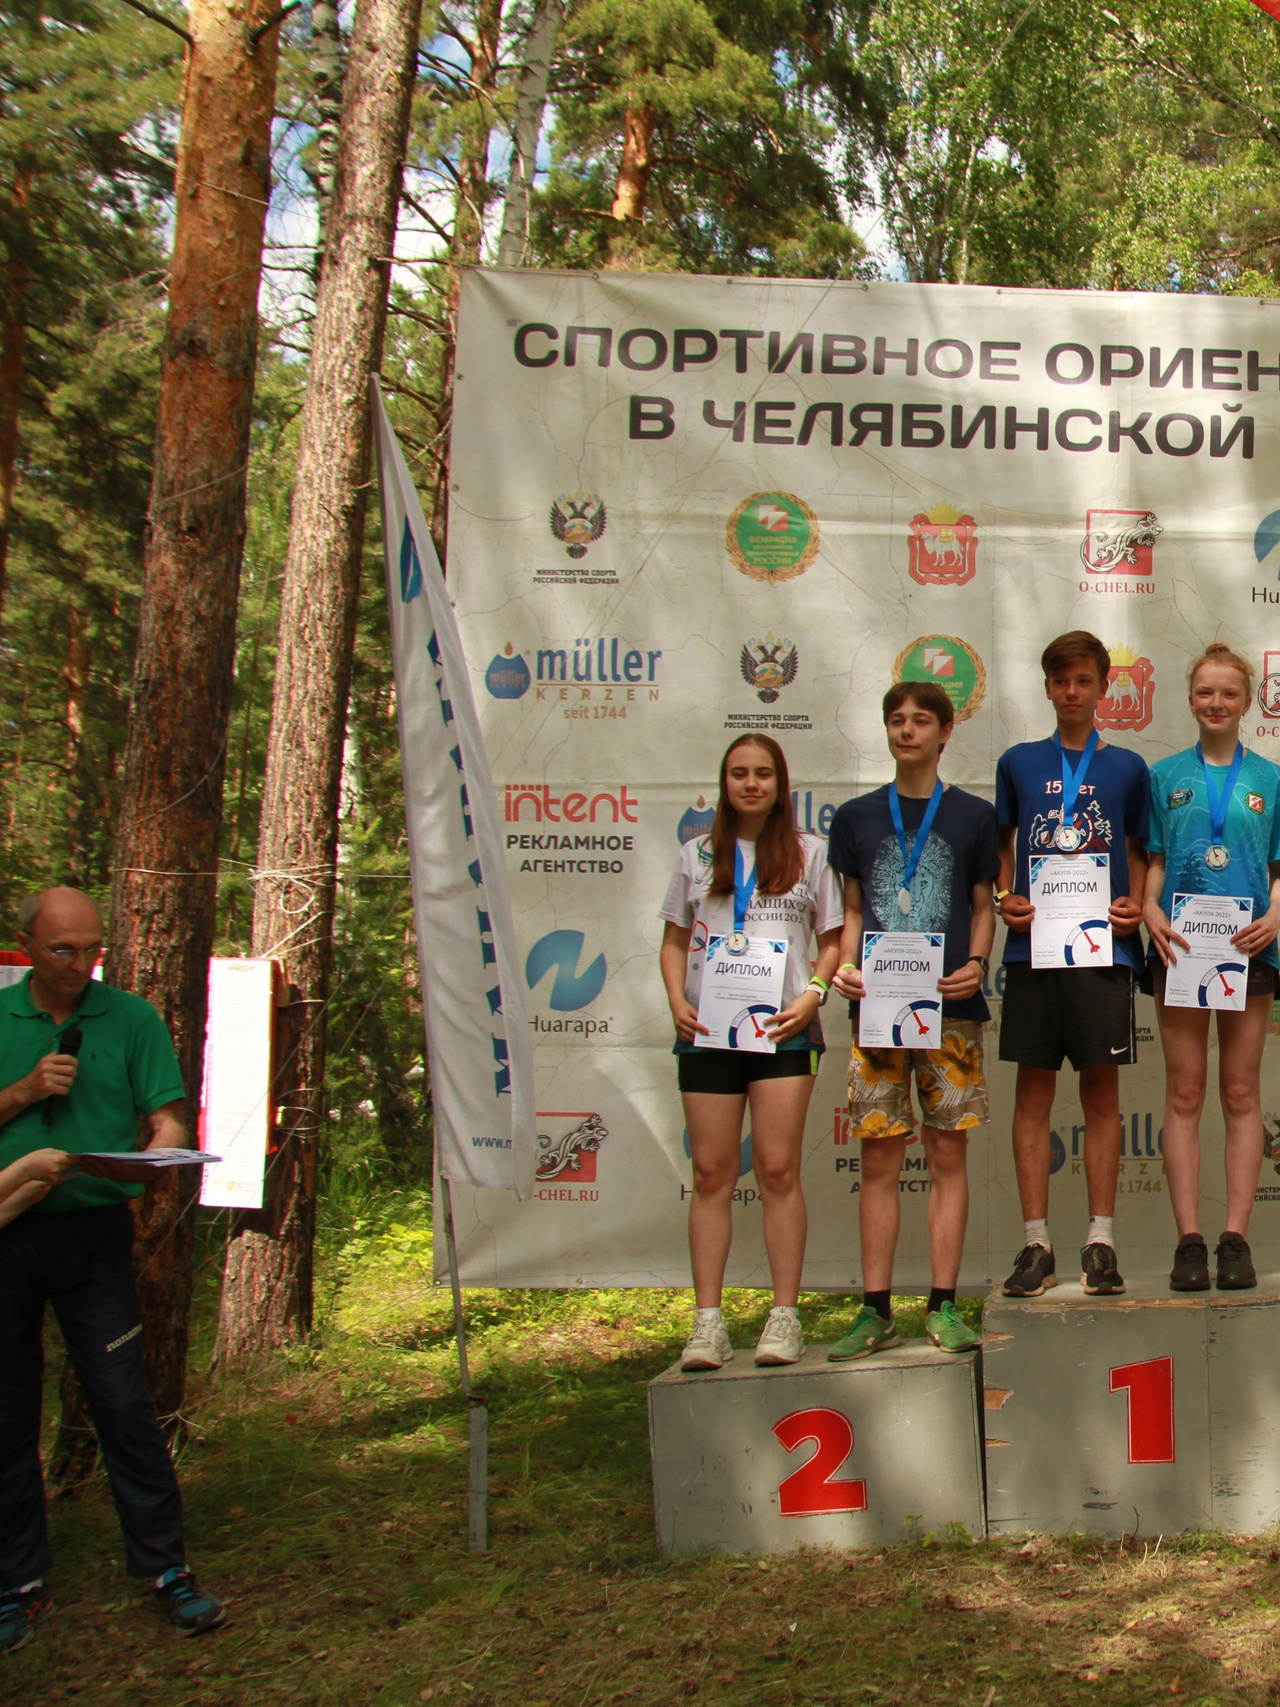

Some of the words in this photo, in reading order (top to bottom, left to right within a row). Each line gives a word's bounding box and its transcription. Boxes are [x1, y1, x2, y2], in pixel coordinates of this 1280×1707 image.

[514, 322, 1021, 382] СПОРТИВНОЕ
[629, 395, 675, 440] В
[703, 400, 1254, 460] ЧЕЛЯБИНСКОЙ
[536, 569, 589, 577] МИНИСТЕРСТВО
[533, 576, 577, 585] РОССИЙСКОЙ
[579, 577, 620, 585] ФЕДЕРАЦИИ
[1079, 581, 1156, 595] O-CHEL.RU
[537, 637, 663, 682] müller
[536, 688, 659, 701] KERZEN
[563, 706, 590, 719] seit
[593, 706, 627, 719] 1744
[783, 714, 809, 722] СПОРТА
[724, 721, 769, 729] РОССИЙСКОЙ
[771, 722, 813, 730] ФЕДЕРАЦИИ
[1045, 780, 1062, 794] 15
[505, 784, 638, 823] intent
[506, 834, 634, 851] РЕКЛАМНОЕ
[520, 859, 624, 874] АГЕНТСТВО
[1041, 882, 1098, 896] ДИПЛОМ
[743, 913, 783, 922] ОССИИ
[1182, 921, 1239, 935] ДИПЛОМ
[715, 961, 772, 977] ДИПЛОМ
[873, 960, 930, 973] ДИПЛОМ
[1128, 1180, 1162, 1193] 1744
[533, 1189, 600, 1202] -CHEL.RU
[1108, 1355, 1176, 1464] 1
[771, 1406, 868, 1518] 2
